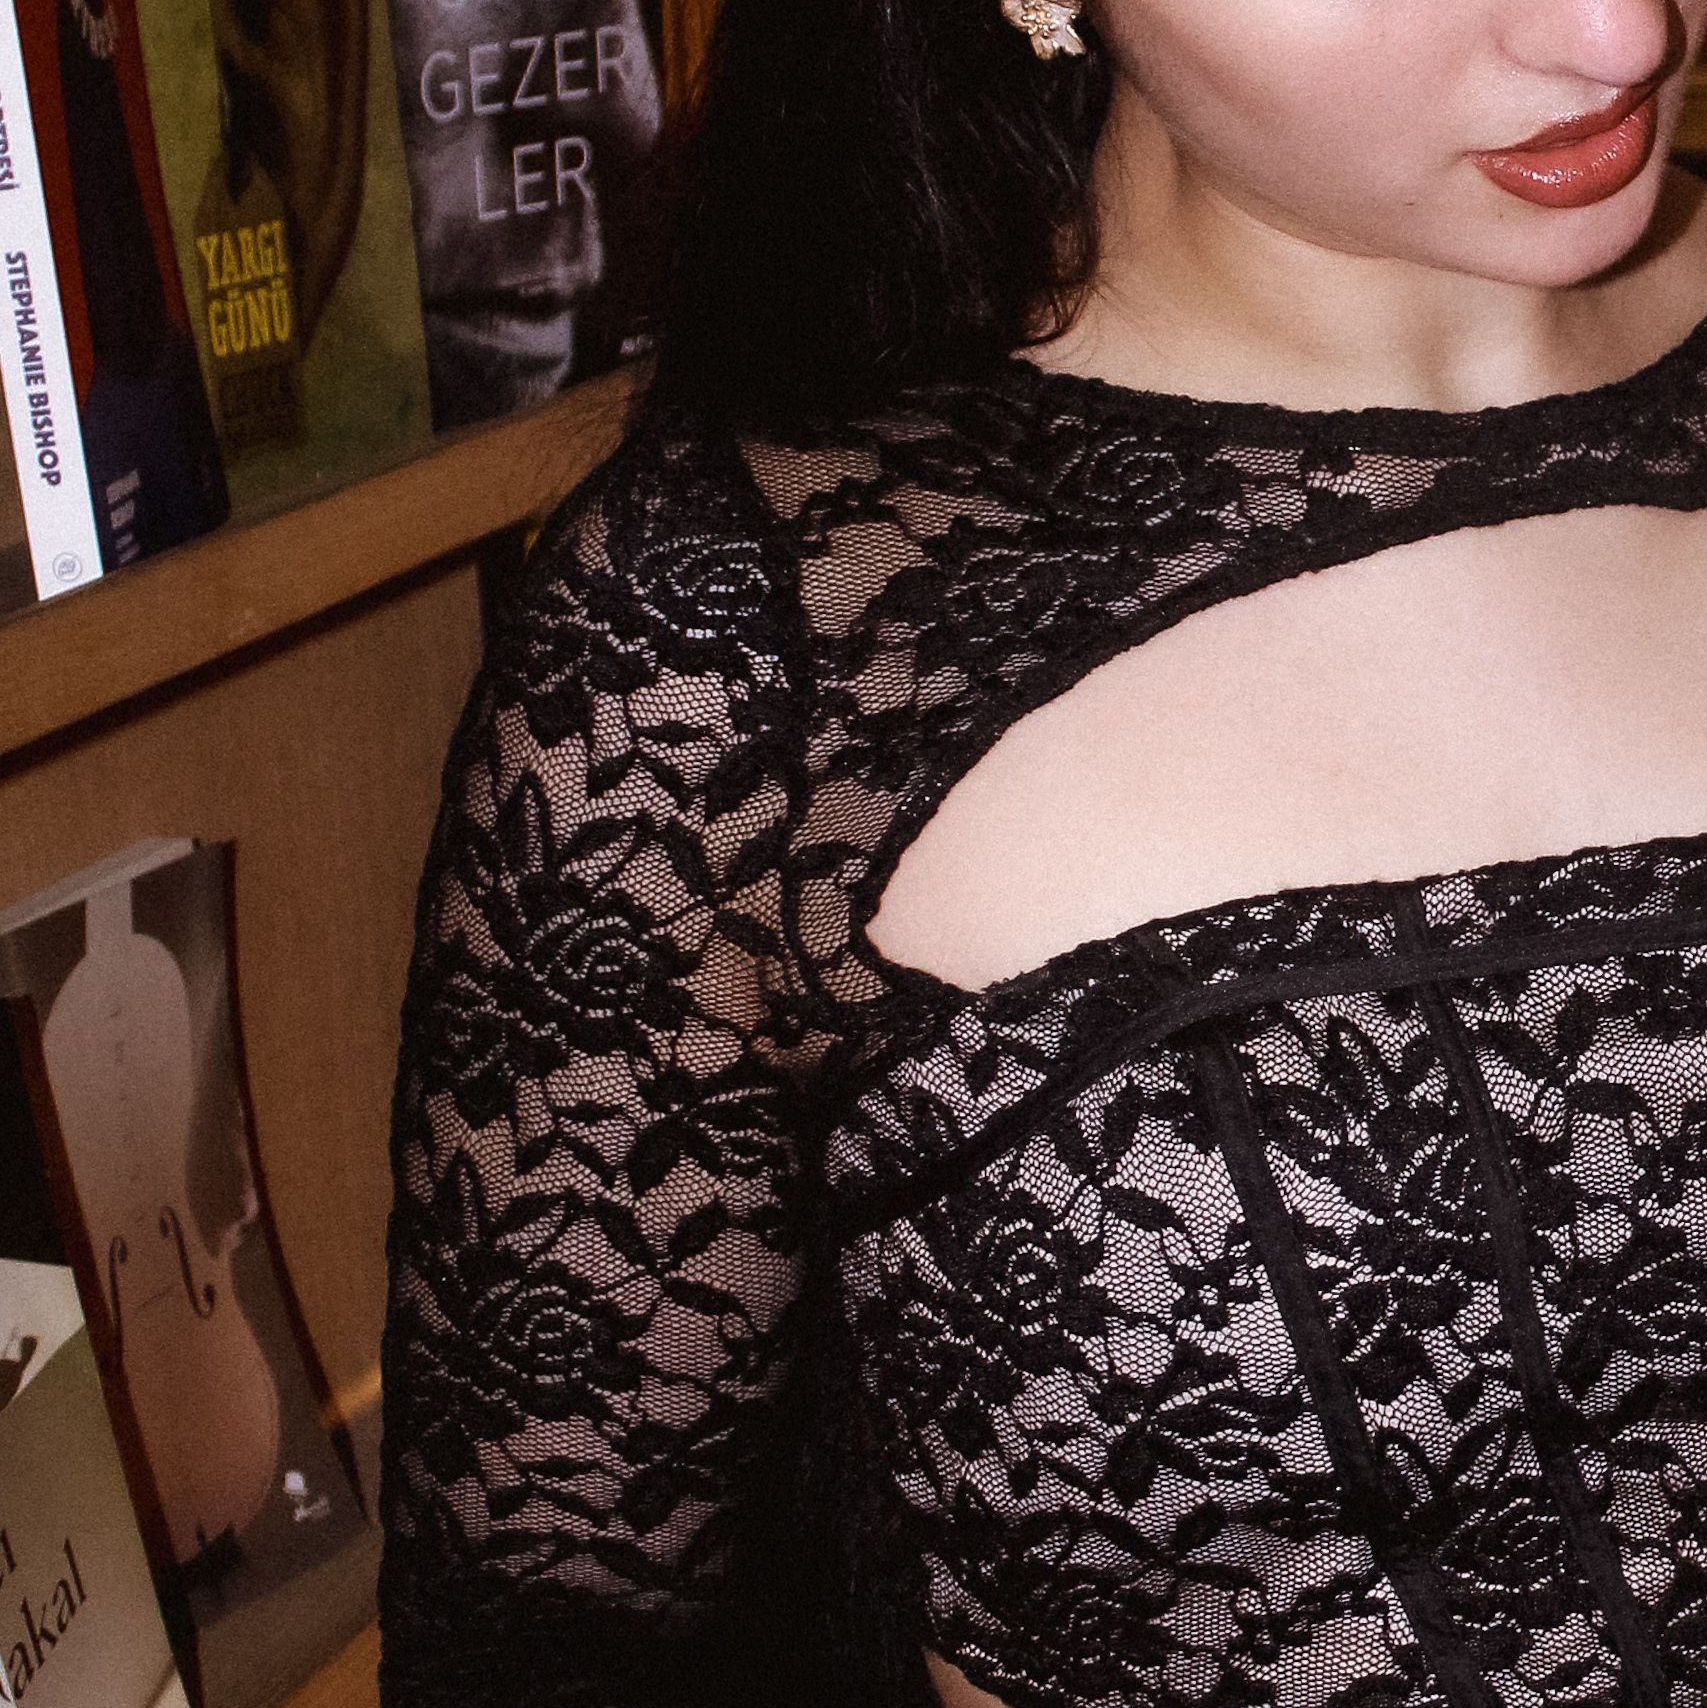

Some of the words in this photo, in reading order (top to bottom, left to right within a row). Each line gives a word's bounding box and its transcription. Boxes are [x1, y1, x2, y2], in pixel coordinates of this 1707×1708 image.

[420, 23, 637, 124] GEZER
[474, 135, 595, 223] LER
[197, 219, 288, 290] YARGI
[207, 277, 291, 358] GÜNÜ
[6, 250, 46, 387] STEPHANIE
[28, 391, 62, 486] BISHOP
[0, 1537, 87, 1703] akal
